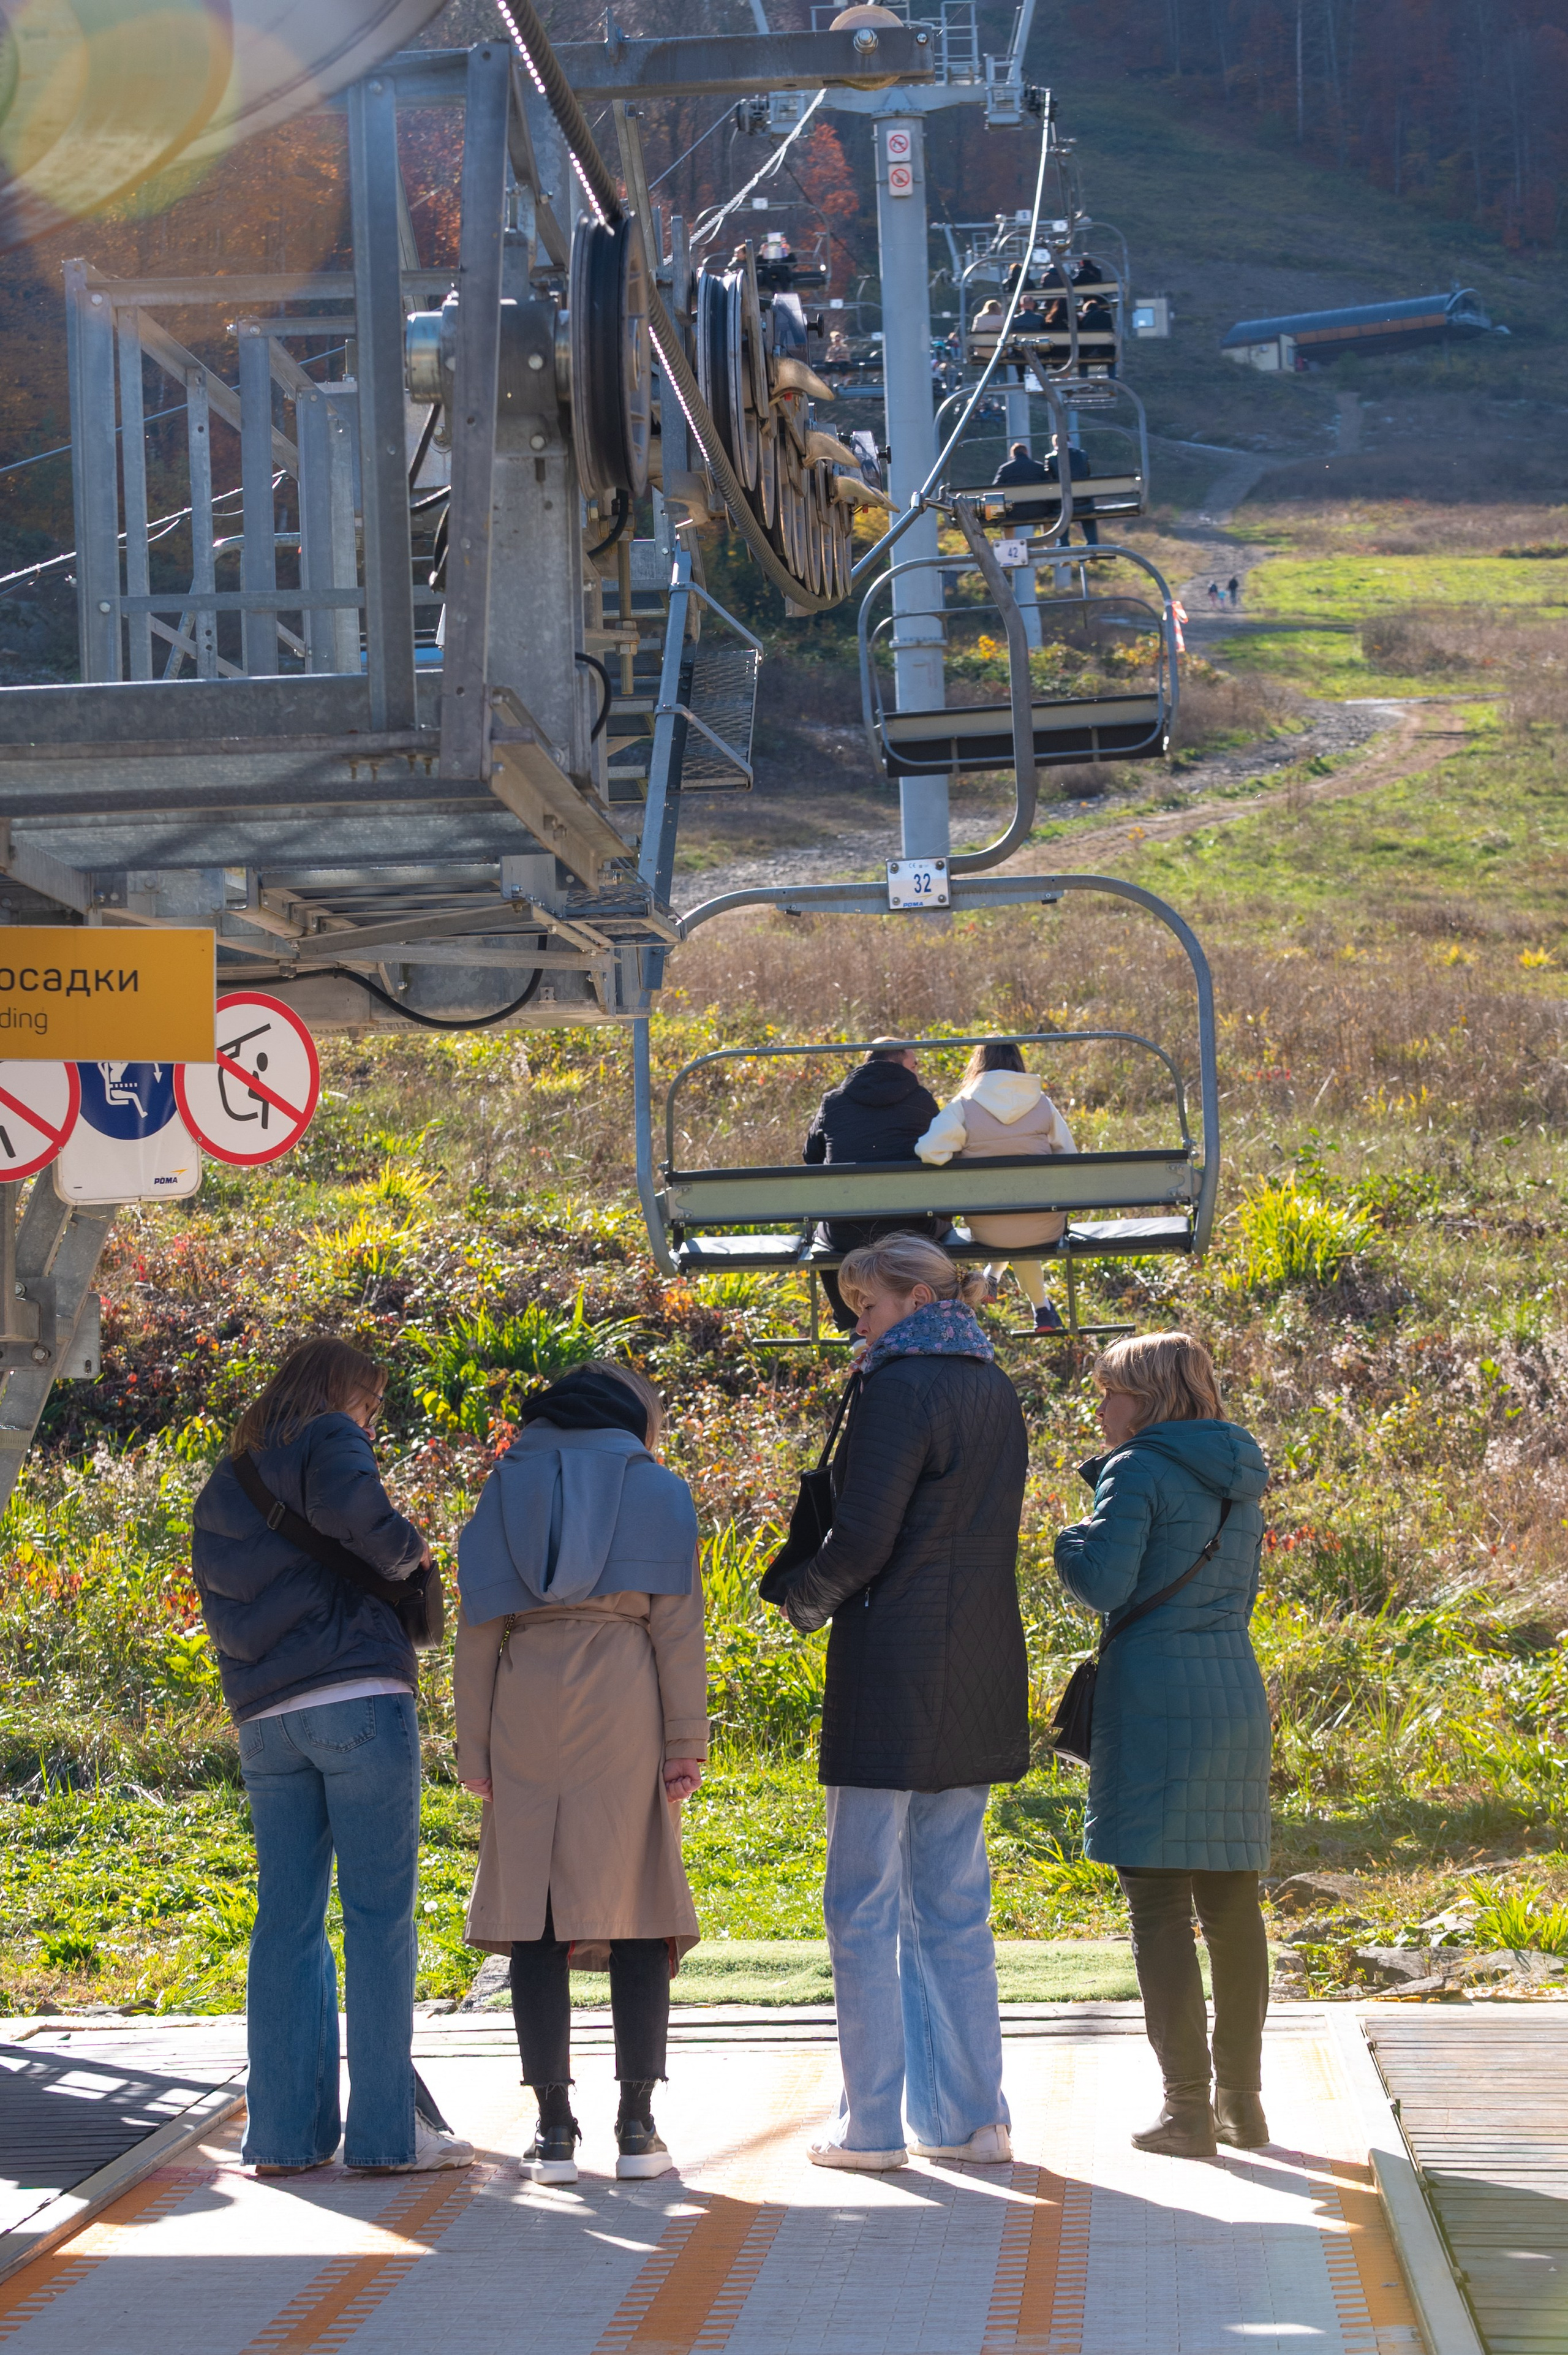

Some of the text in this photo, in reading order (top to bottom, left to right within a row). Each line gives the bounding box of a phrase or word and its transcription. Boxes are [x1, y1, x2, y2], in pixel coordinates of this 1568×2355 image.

[1008, 547, 1019, 558] 42
[913, 873, 932, 893] 32
[0, 968, 138, 997] осадки
[0, 1007, 48, 1035] ding
